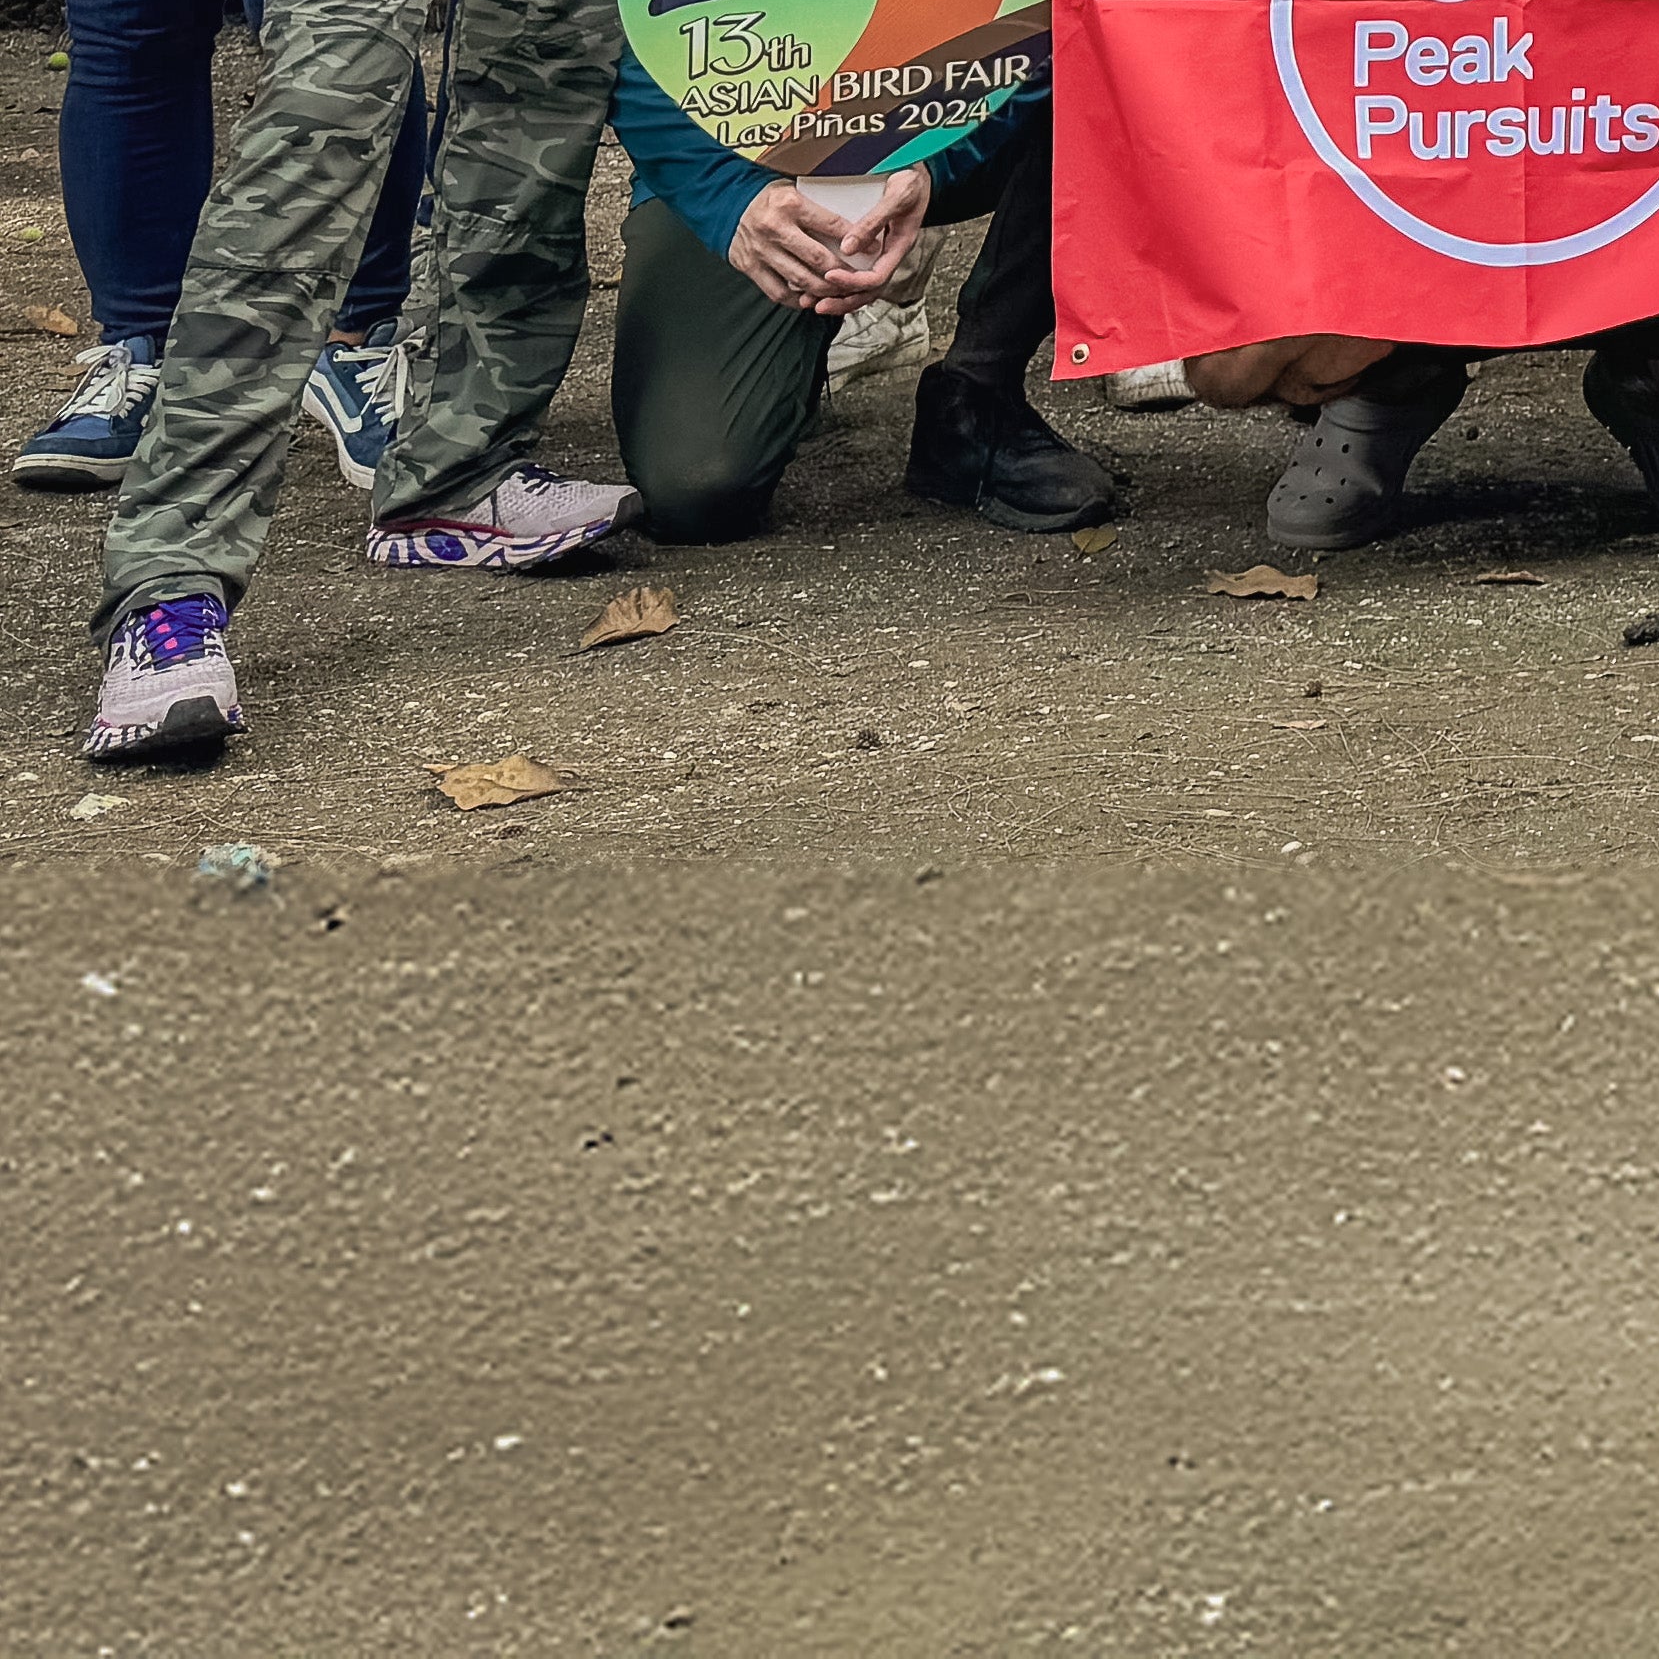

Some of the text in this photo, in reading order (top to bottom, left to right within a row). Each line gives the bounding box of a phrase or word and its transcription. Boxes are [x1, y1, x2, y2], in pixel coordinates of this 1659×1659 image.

[679, 11, 811, 80] 13th
[1354, 16, 1534, 88] Peak
[680, 54, 1032, 118] ASIAN BIRD FAIR
[716, 97, 991, 148] Las Piñas 2024
